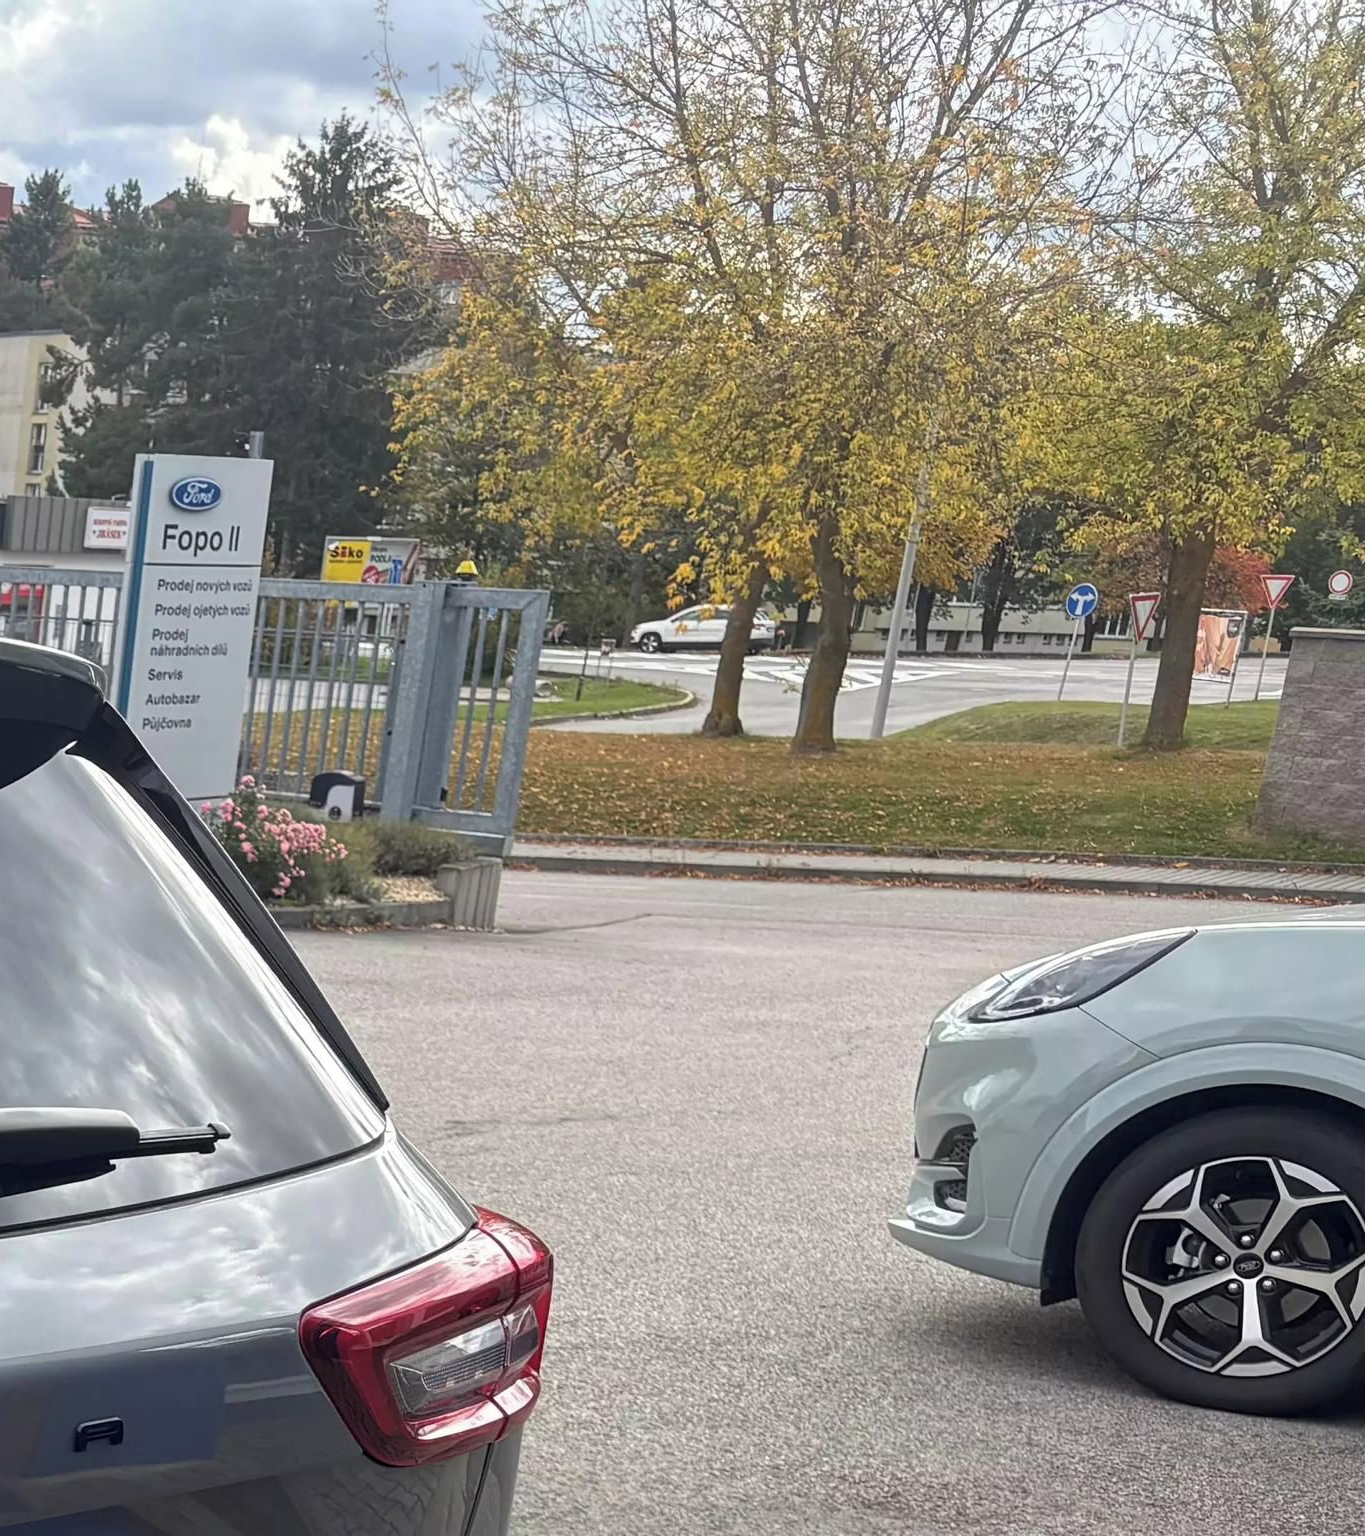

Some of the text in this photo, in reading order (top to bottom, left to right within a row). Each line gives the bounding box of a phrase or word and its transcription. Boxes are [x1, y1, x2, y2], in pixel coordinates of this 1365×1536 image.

[162, 524, 224, 557] Fopo
[157, 579, 194, 593] Prodej
[195, 580, 231, 594] nových
[154, 604, 191, 618] Prodej
[193, 604, 229, 618] ojetých
[152, 628, 189, 643] Prodej
[150, 644, 209, 657] náhradních
[148, 668, 183, 680] Servis
[145, 692, 201, 706] Autobazar
[142, 716, 192, 732] Půjčovna
